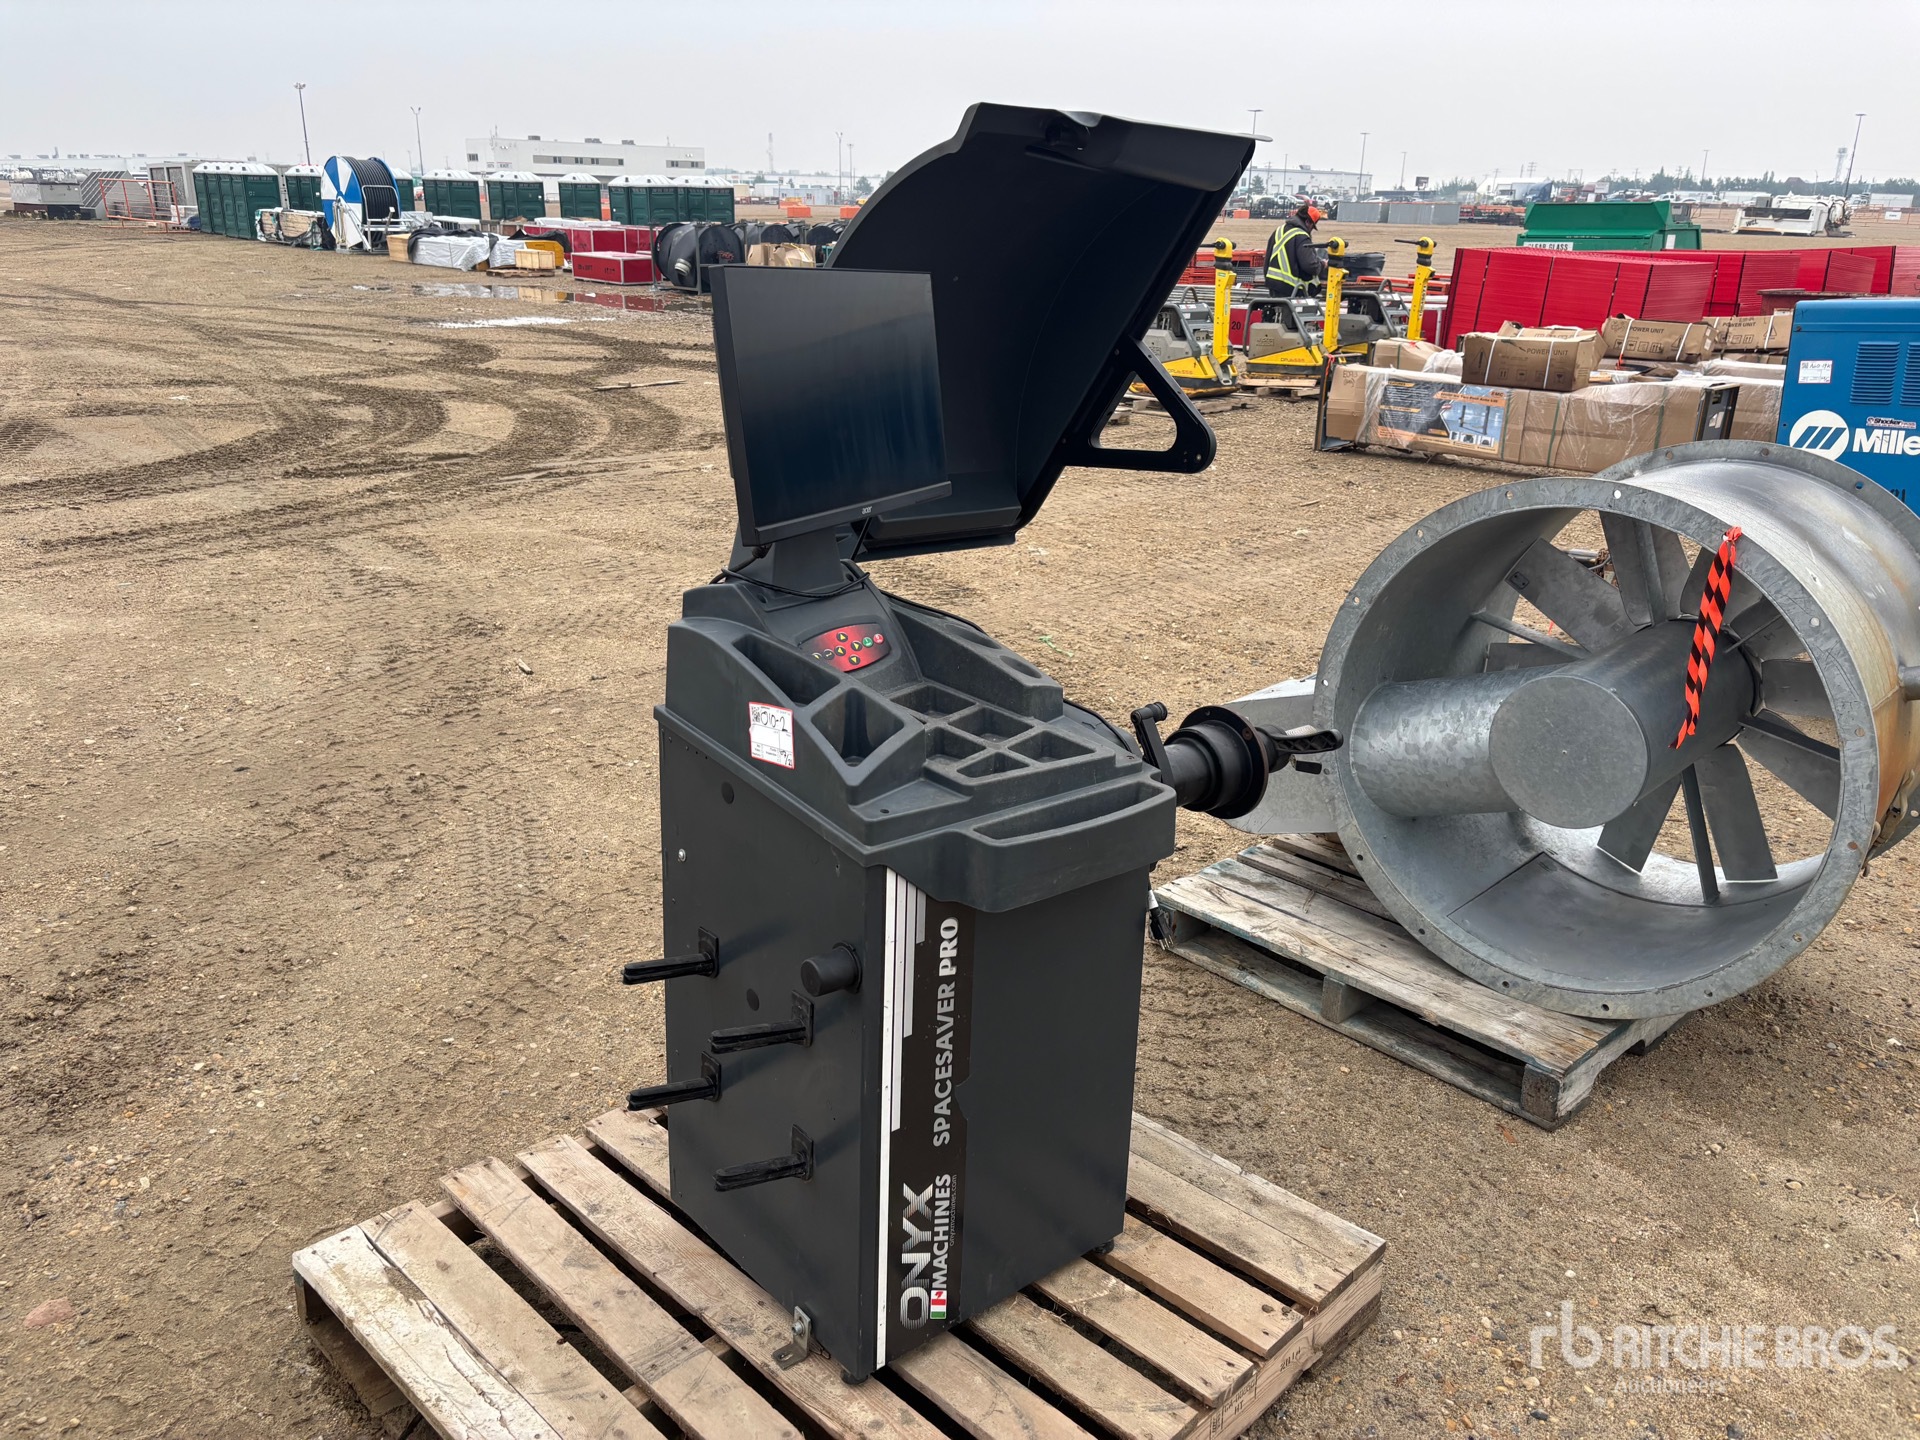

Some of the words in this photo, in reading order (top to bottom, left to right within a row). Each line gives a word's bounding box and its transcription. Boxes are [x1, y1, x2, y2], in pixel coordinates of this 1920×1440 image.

[1548, 243, 1569, 251] GLASS
[1231, 321, 1242, 330] 20
[1526, 347, 1550, 355] POWER
[1852, 427, 1920, 456] Mille
[861, 505, 873, 515] acer
[938, 917, 959, 977] PRO
[932, 981, 957, 1148] SPACESAVER
[931, 1173, 952, 1290] MACHINES
[949, 1174, 958, 1247] onyxmachines.com
[899, 1182, 934, 1330] ONYX
